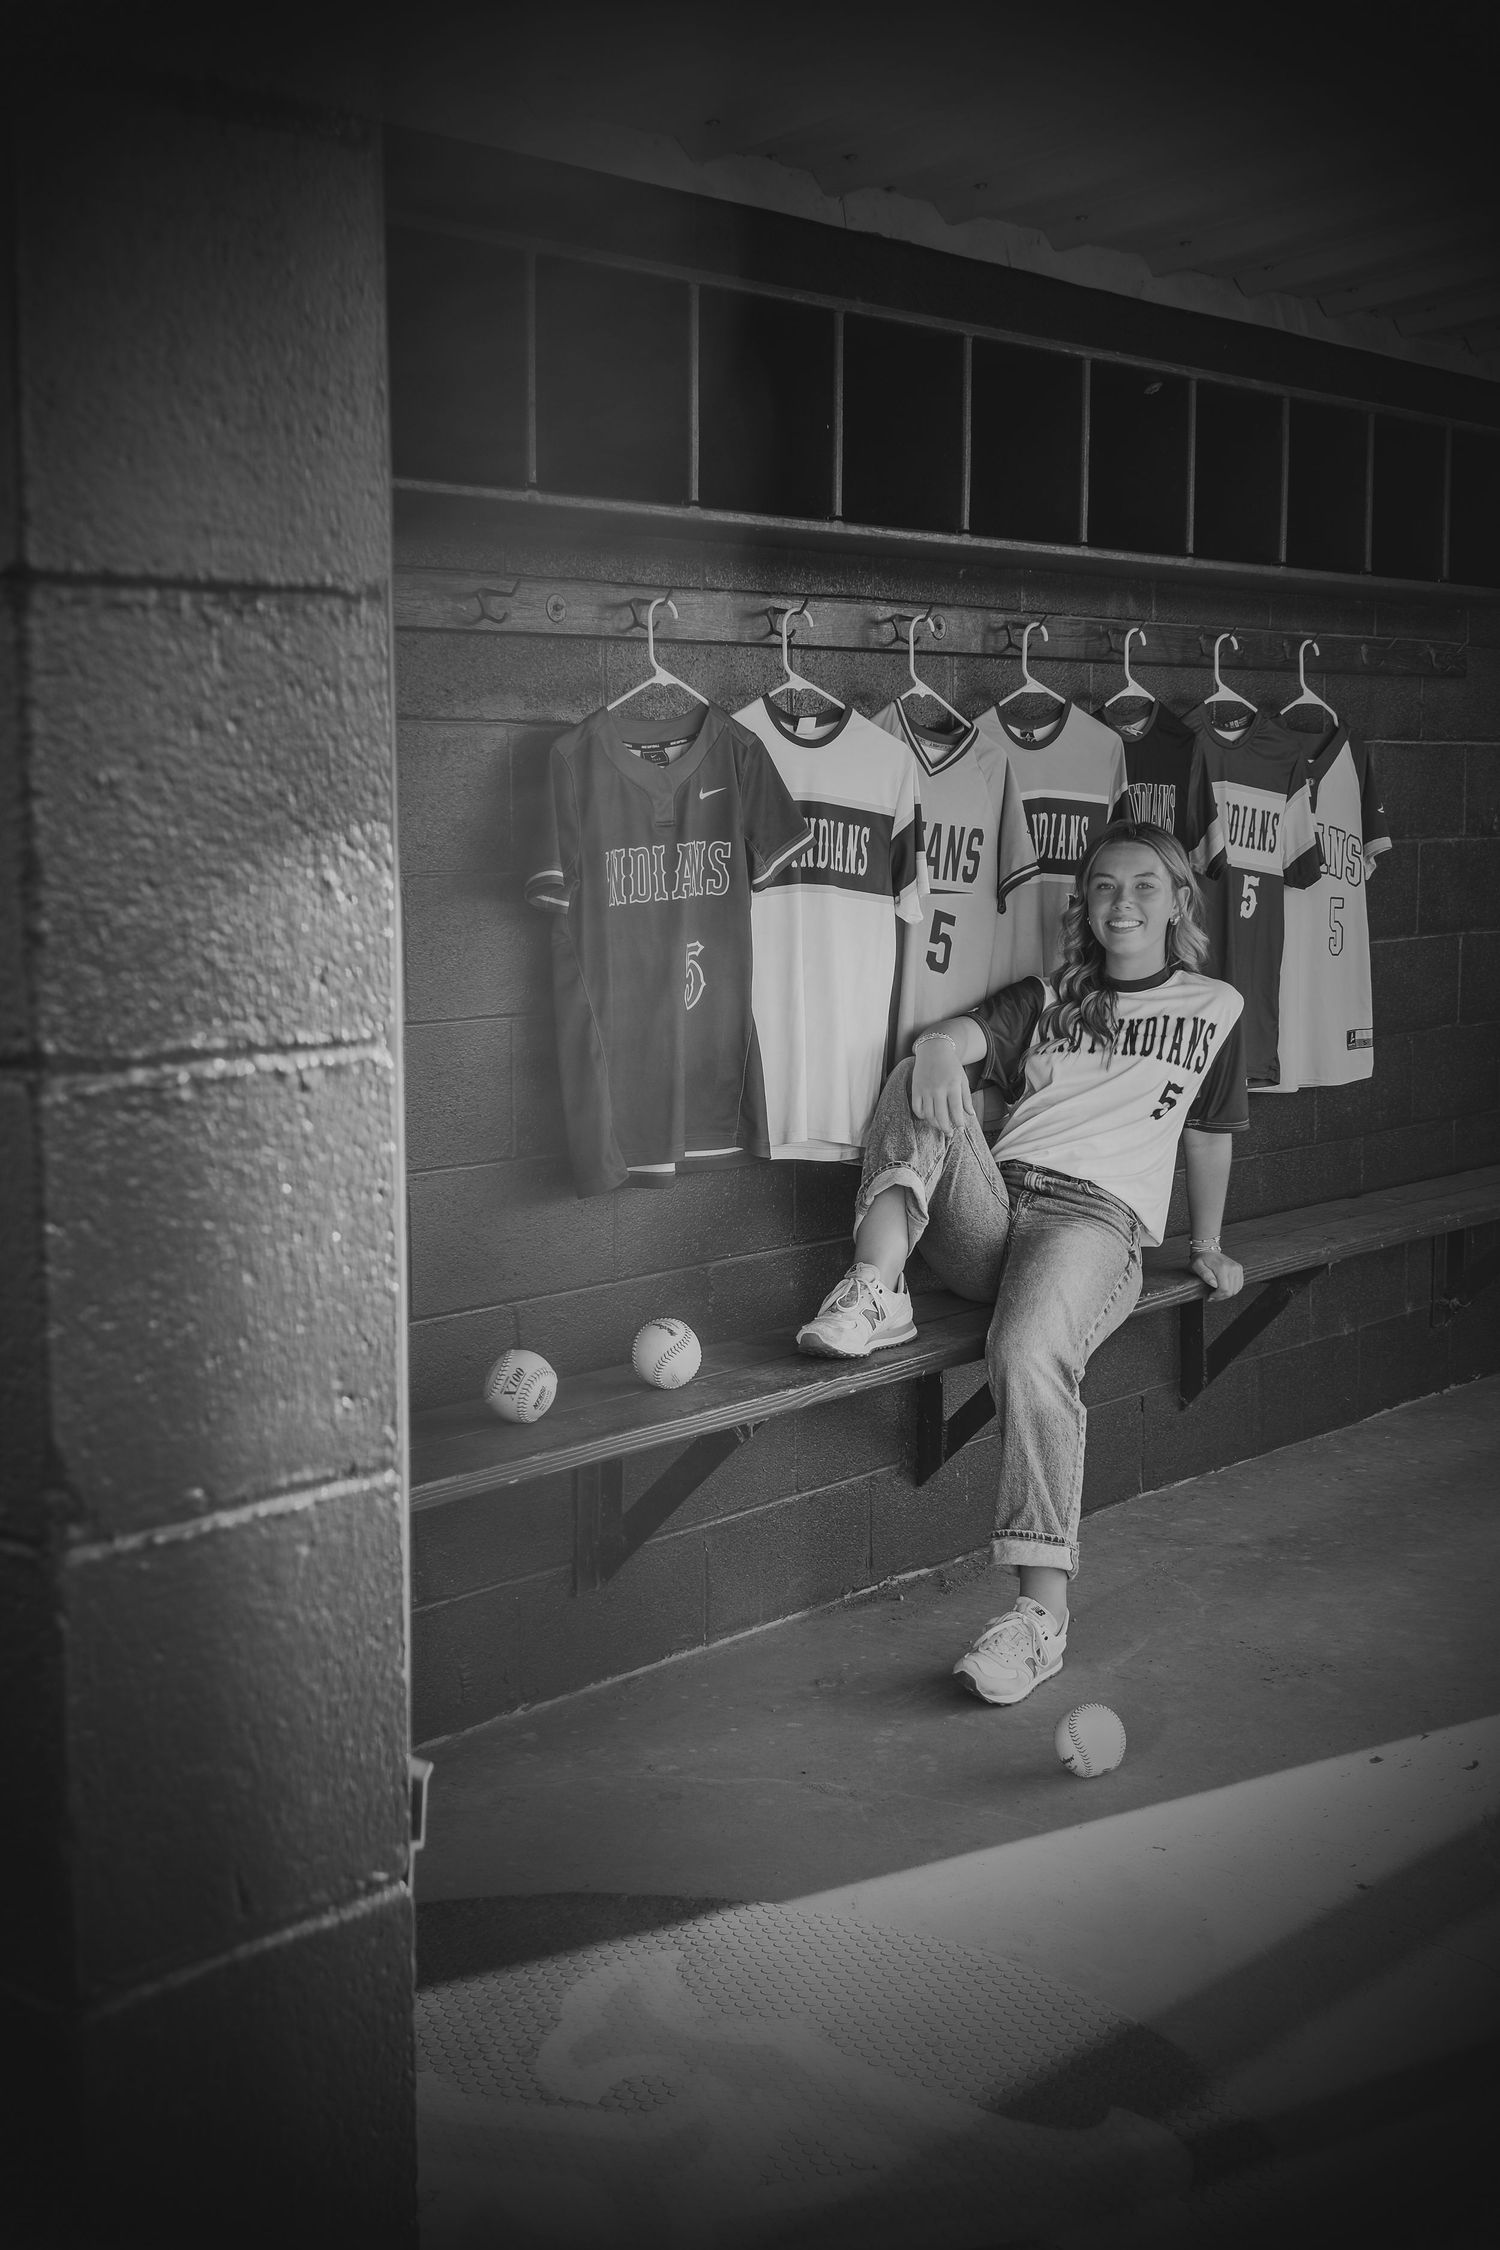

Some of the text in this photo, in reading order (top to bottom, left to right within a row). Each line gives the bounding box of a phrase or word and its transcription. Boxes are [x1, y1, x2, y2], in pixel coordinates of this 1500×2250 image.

[792, 816, 871, 876] NDIANS
[922, 821, 985, 884] ANS
[1226, 801, 1280, 854] DIANS
[1240, 874, 1260, 919] 5
[1328, 896, 1345, 956] 5
[926, 909, 956, 975] 5
[684, 940, 707, 1011] 5
[1149, 1080, 1184, 1121] 5
